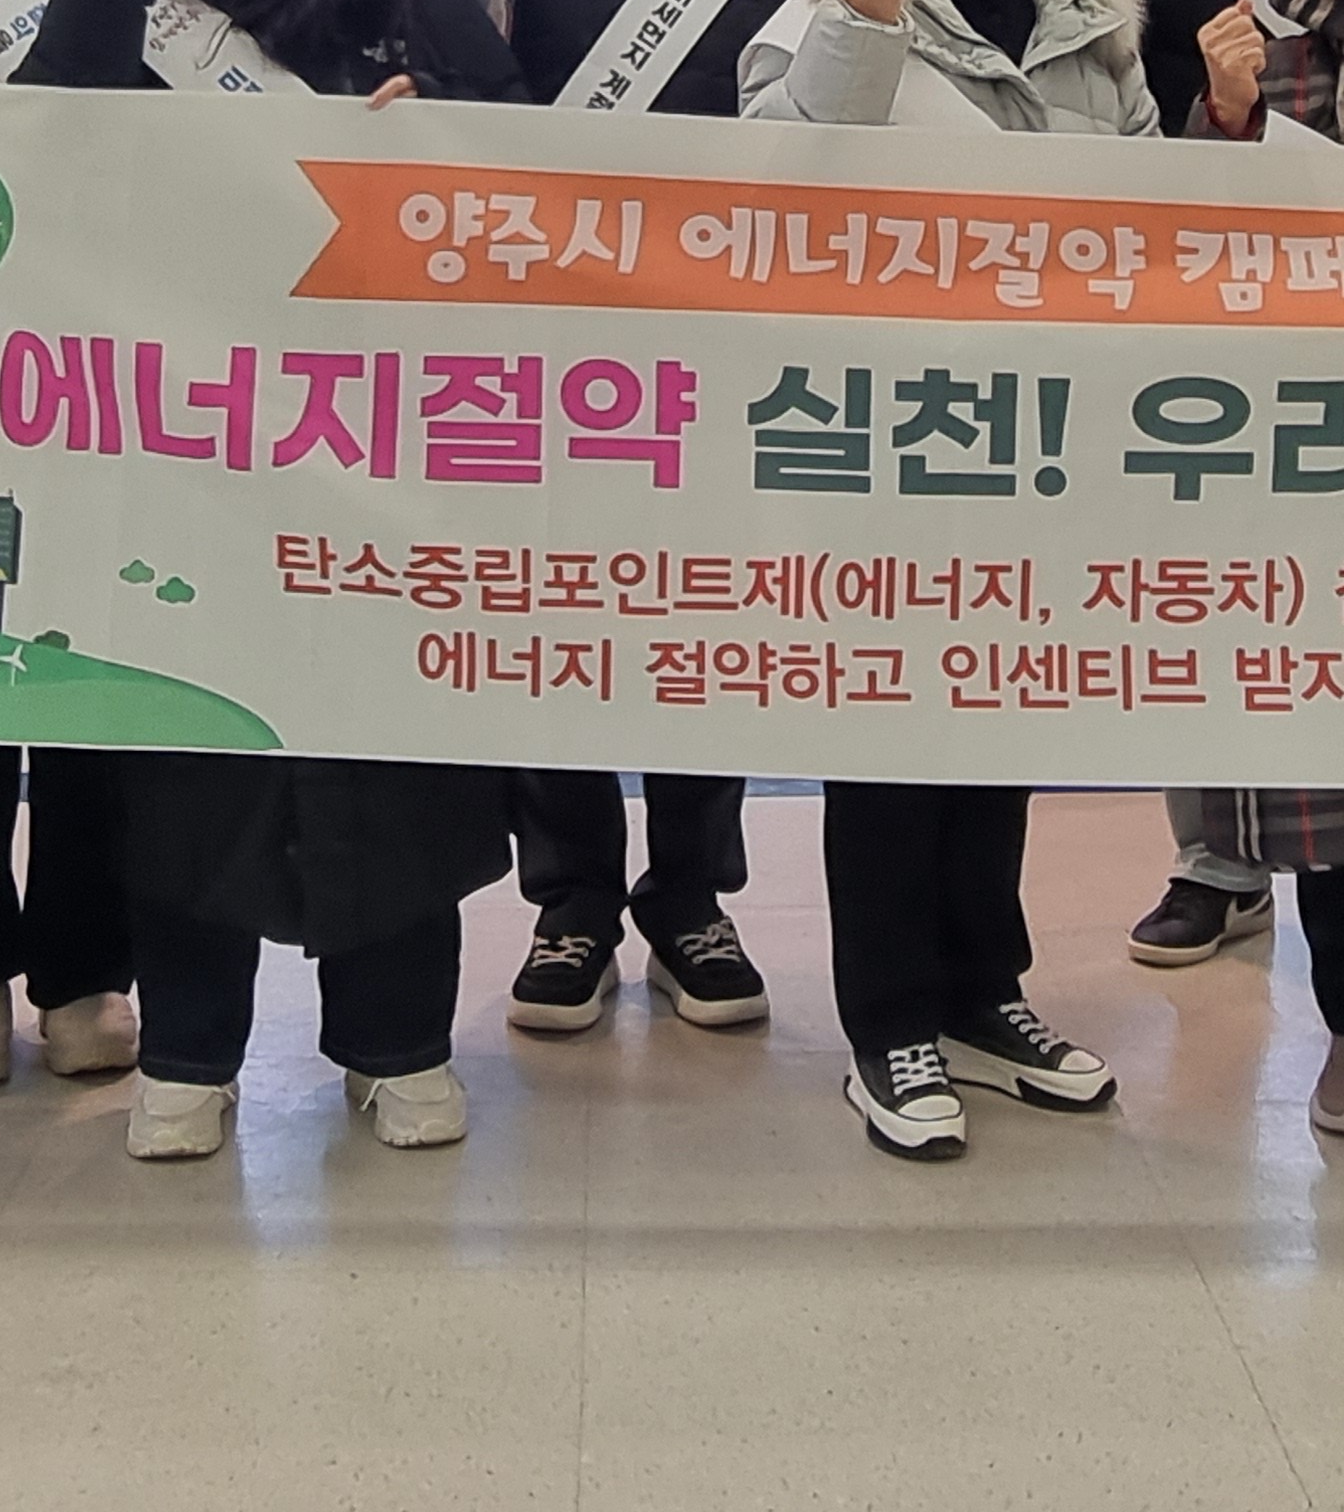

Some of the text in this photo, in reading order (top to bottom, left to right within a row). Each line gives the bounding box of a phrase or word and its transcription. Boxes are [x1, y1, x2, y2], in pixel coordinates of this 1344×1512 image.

[400, 191, 643, 284] 양주시
[680, 204, 1147, 311] 에너지절약
[0, 331, 697, 489] 에너지절약
[747, 365, 1072, 498] 실천!
[276, 534, 1052, 624] 탄소중립포인트제(에너지,
[1086, 558, 1306, 626] 자동차)
[419, 634, 613, 702] 에너지
[646, 641, 910, 707] 절약하고
[941, 645, 1207, 710] 인센티브
